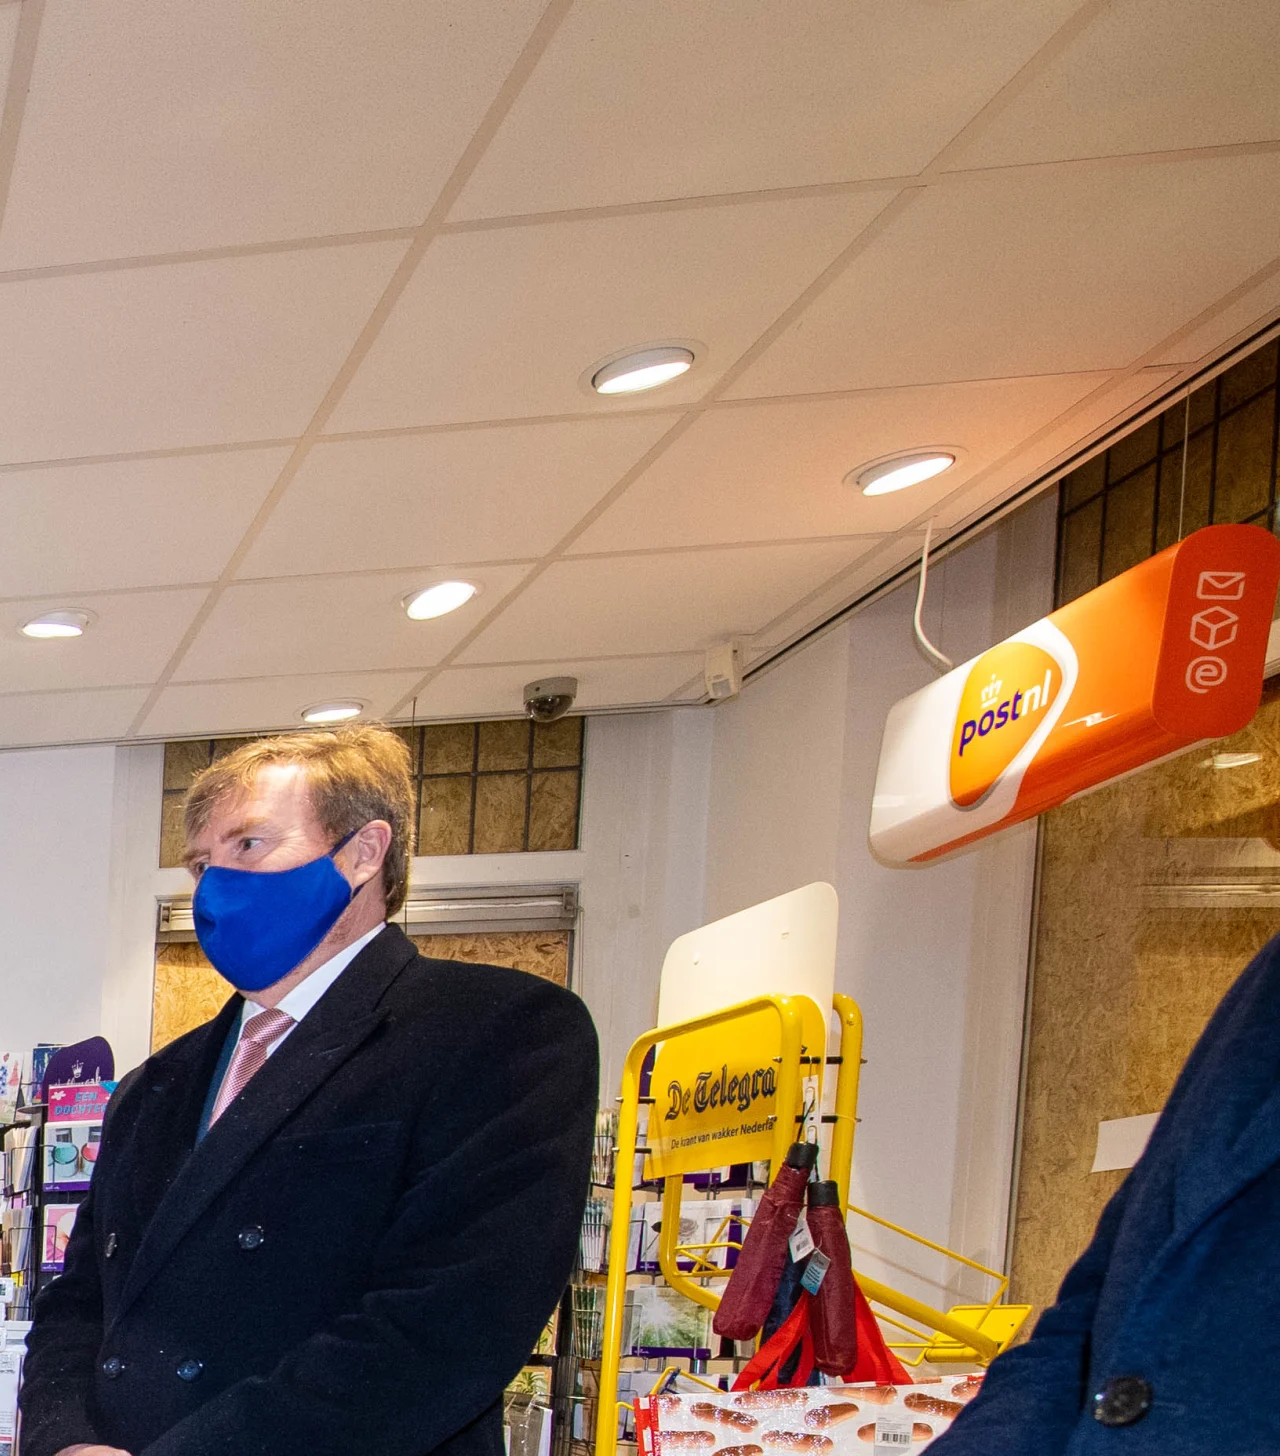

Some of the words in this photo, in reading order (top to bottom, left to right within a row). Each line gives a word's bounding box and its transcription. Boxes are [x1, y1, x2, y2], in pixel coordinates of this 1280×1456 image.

[958, 668, 1052, 757] postnl
[665, 1080, 691, 1121] De
[693, 1064, 777, 1113] Telegra
[671, 1138, 680, 1150] De
[680, 1134, 697, 1148] krant
[698, 1133, 710, 1144] van
[711, 1125, 739, 1140] wakker
